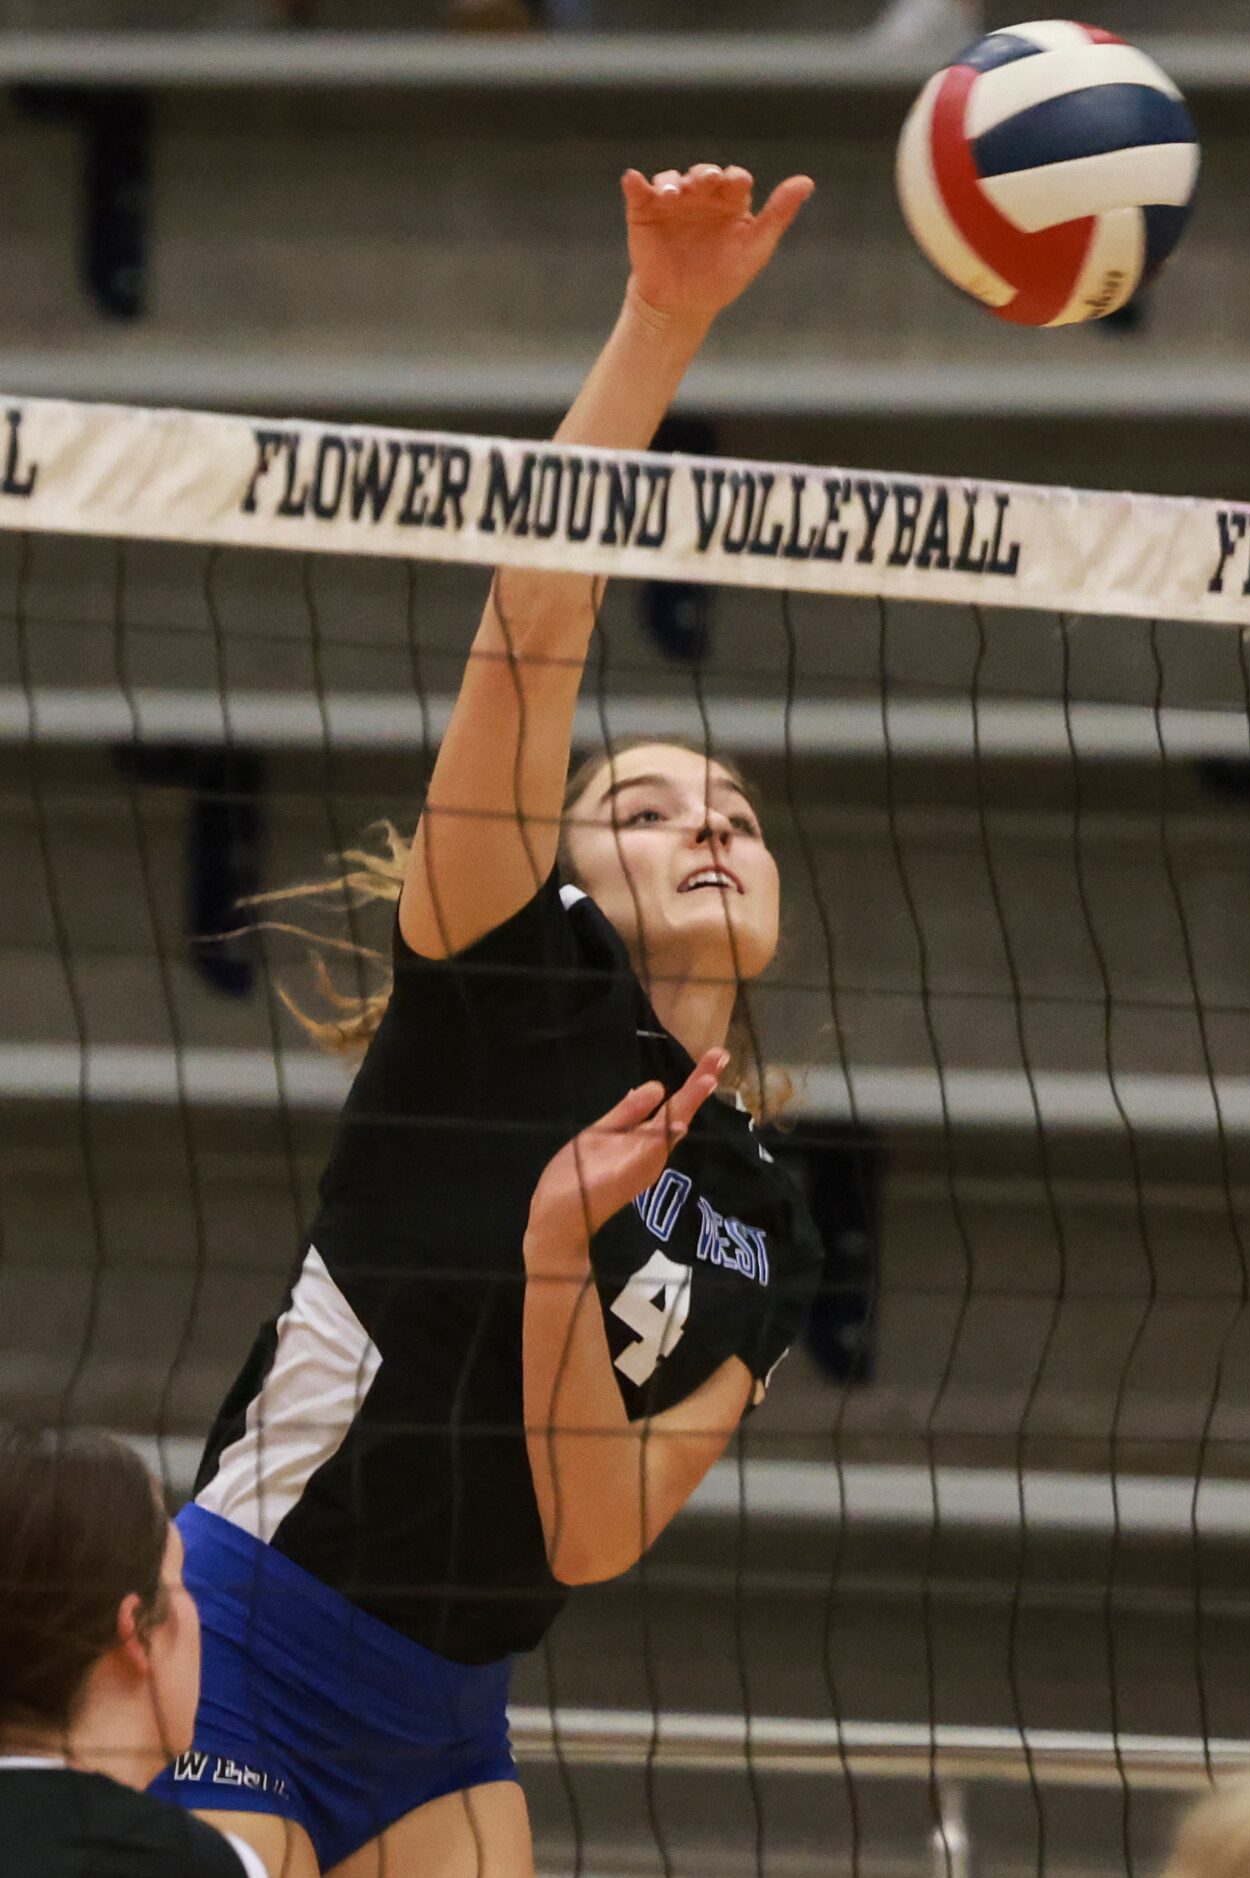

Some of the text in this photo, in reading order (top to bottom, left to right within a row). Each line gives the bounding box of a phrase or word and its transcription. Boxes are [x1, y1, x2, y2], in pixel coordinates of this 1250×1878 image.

[239, 428, 1020, 577] FLOWER MOUND VOLLEYBALL
[610, 1249, 693, 1388] 4
